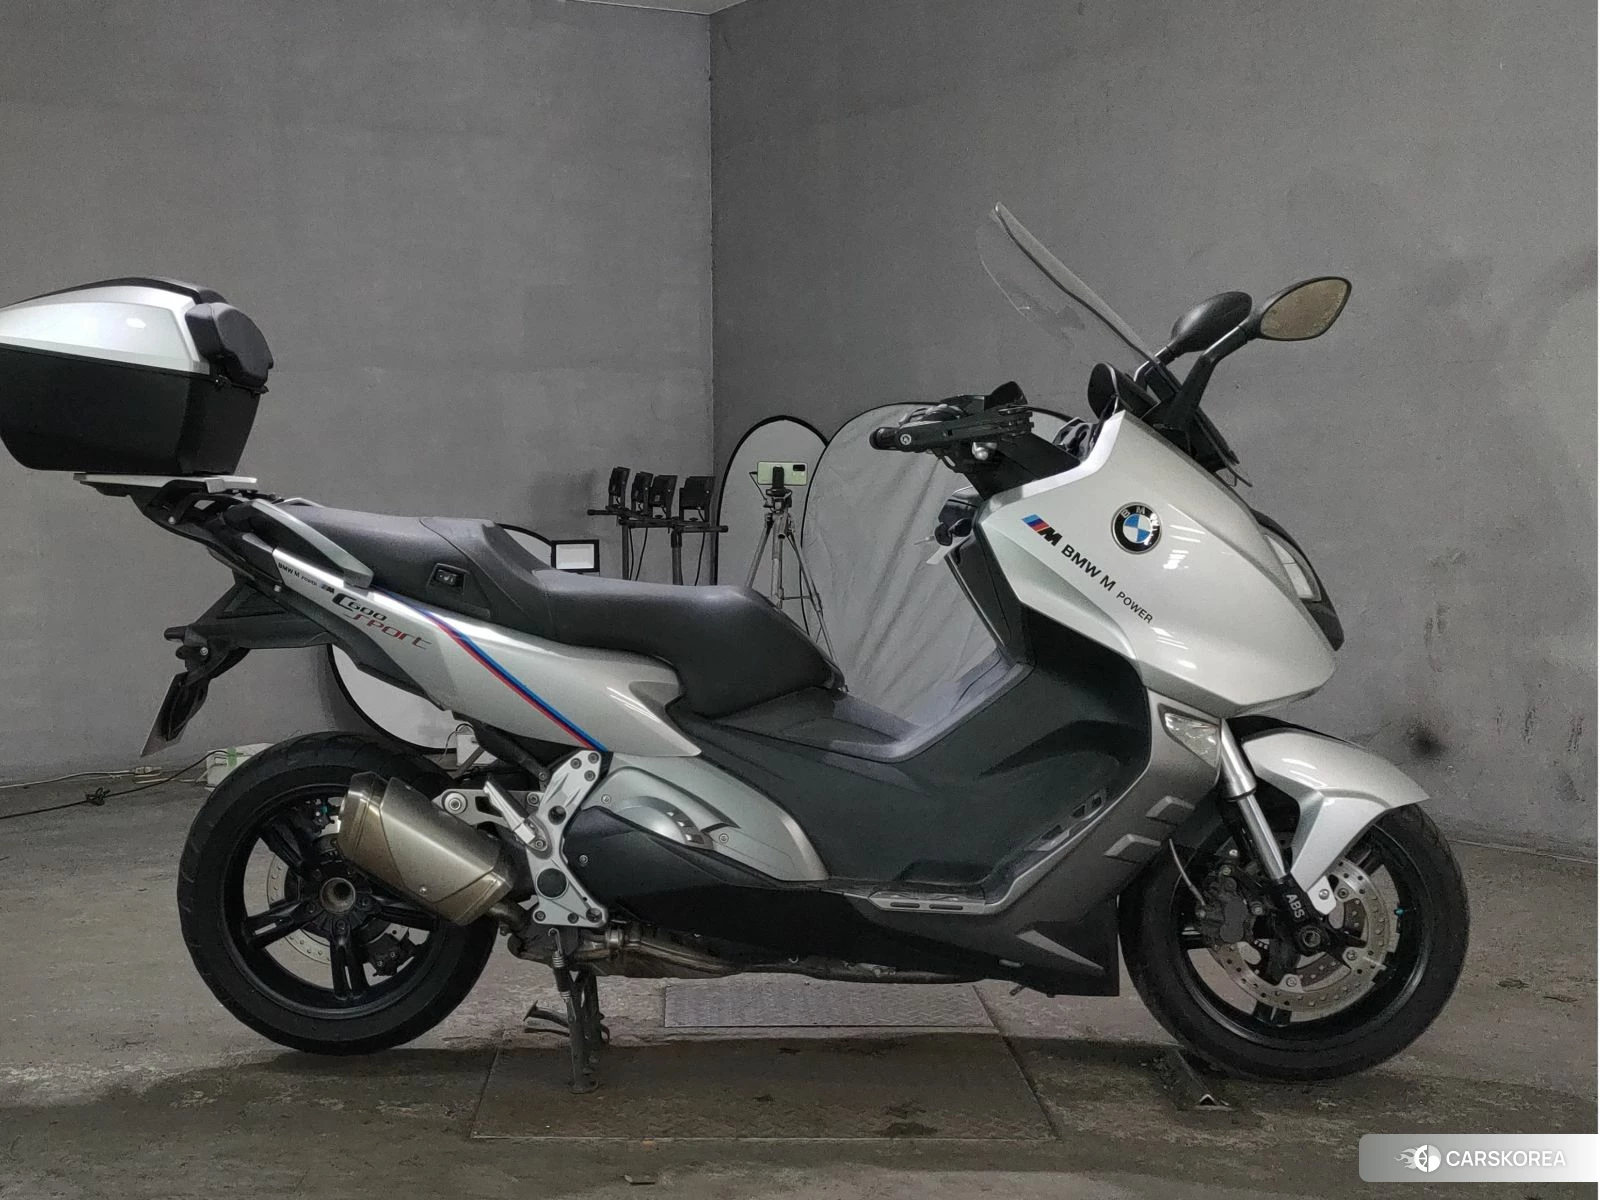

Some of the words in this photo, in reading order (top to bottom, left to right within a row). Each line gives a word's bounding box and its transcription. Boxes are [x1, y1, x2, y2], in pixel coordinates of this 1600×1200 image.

[278, 562, 294, 574] BMW
[1061, 544, 1101, 578] BMW
[1100, 575, 1116, 591] M
[1116, 591, 1153, 624] POWER
[332, 593, 387, 621] C600
[1286, 894, 1305, 918] ABS
